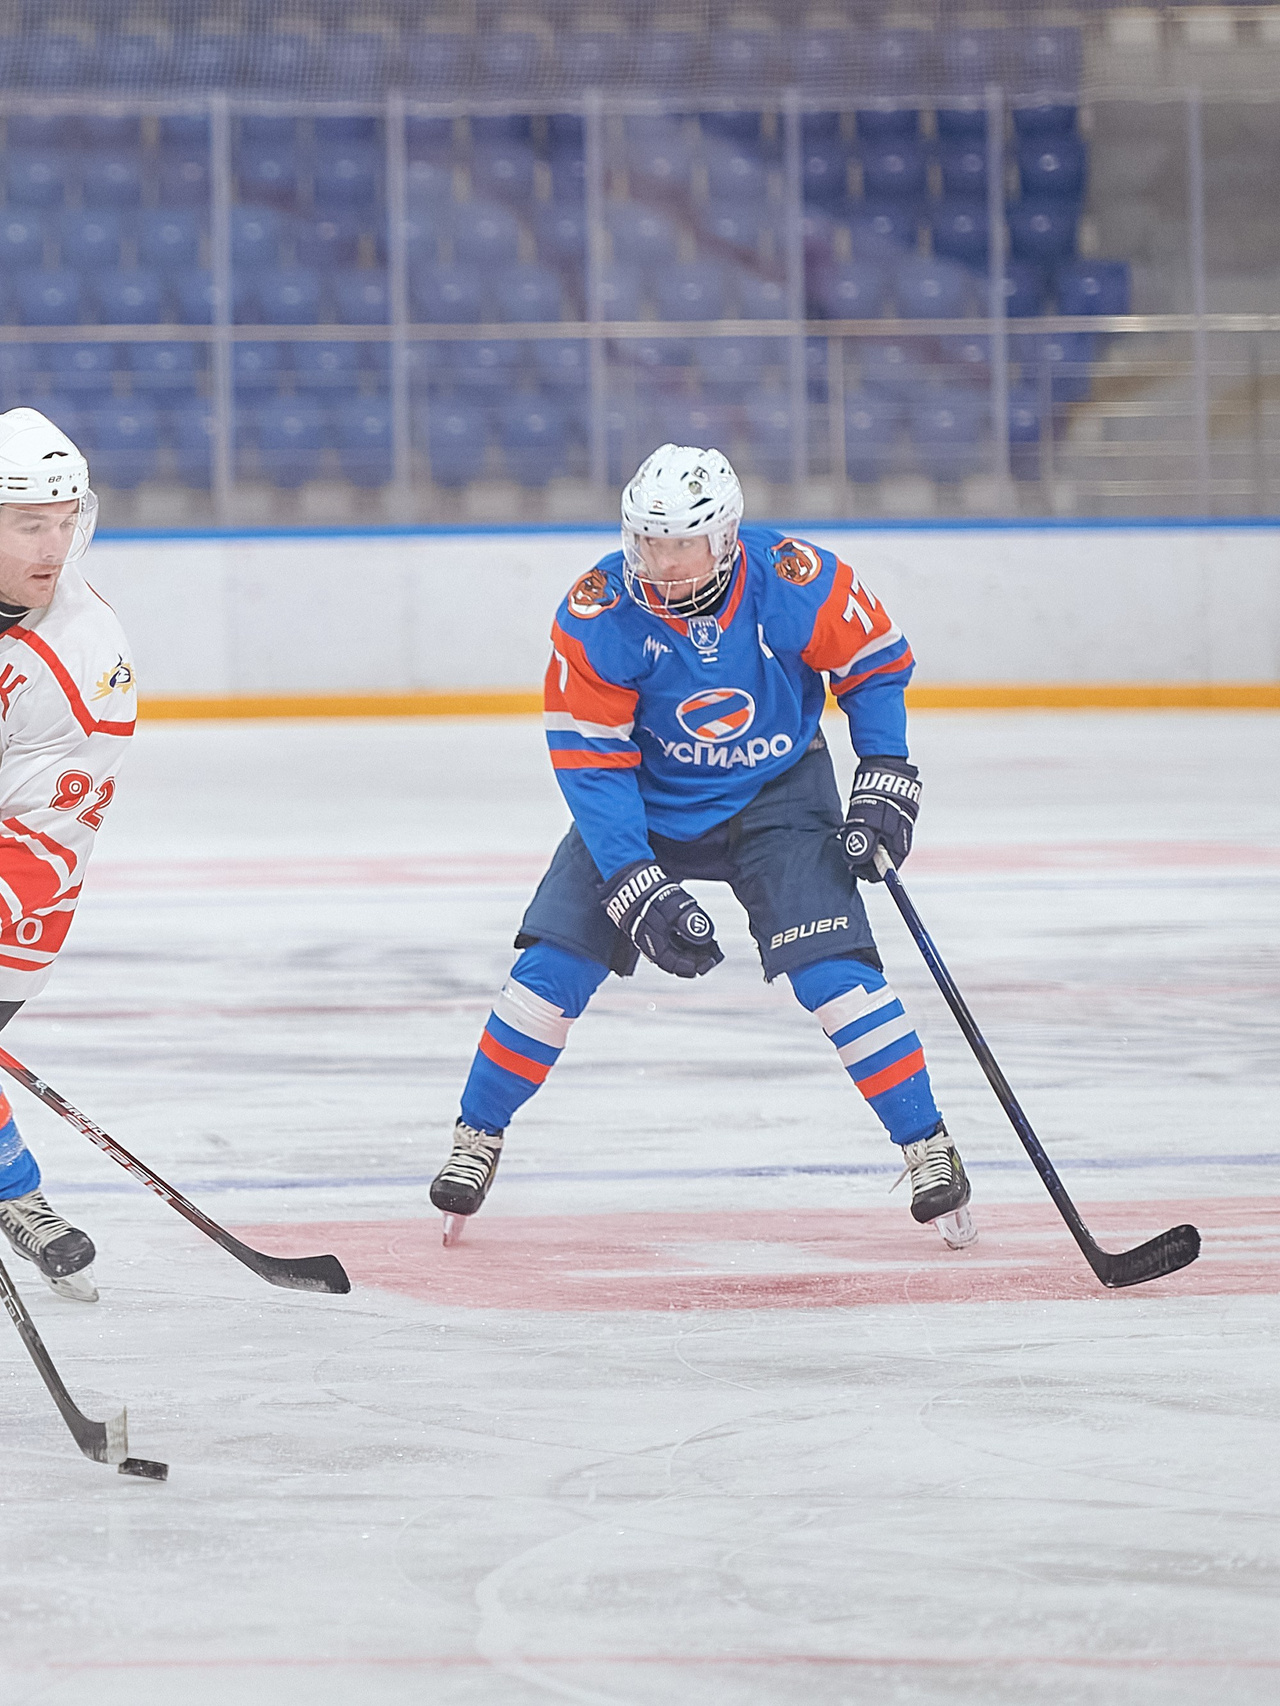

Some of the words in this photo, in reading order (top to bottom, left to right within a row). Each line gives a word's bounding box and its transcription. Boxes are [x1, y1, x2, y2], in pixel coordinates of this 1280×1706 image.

[48, 768, 116, 832] 82
[854, 772, 920, 806] WARR
[770, 916, 850, 950] BAUER
